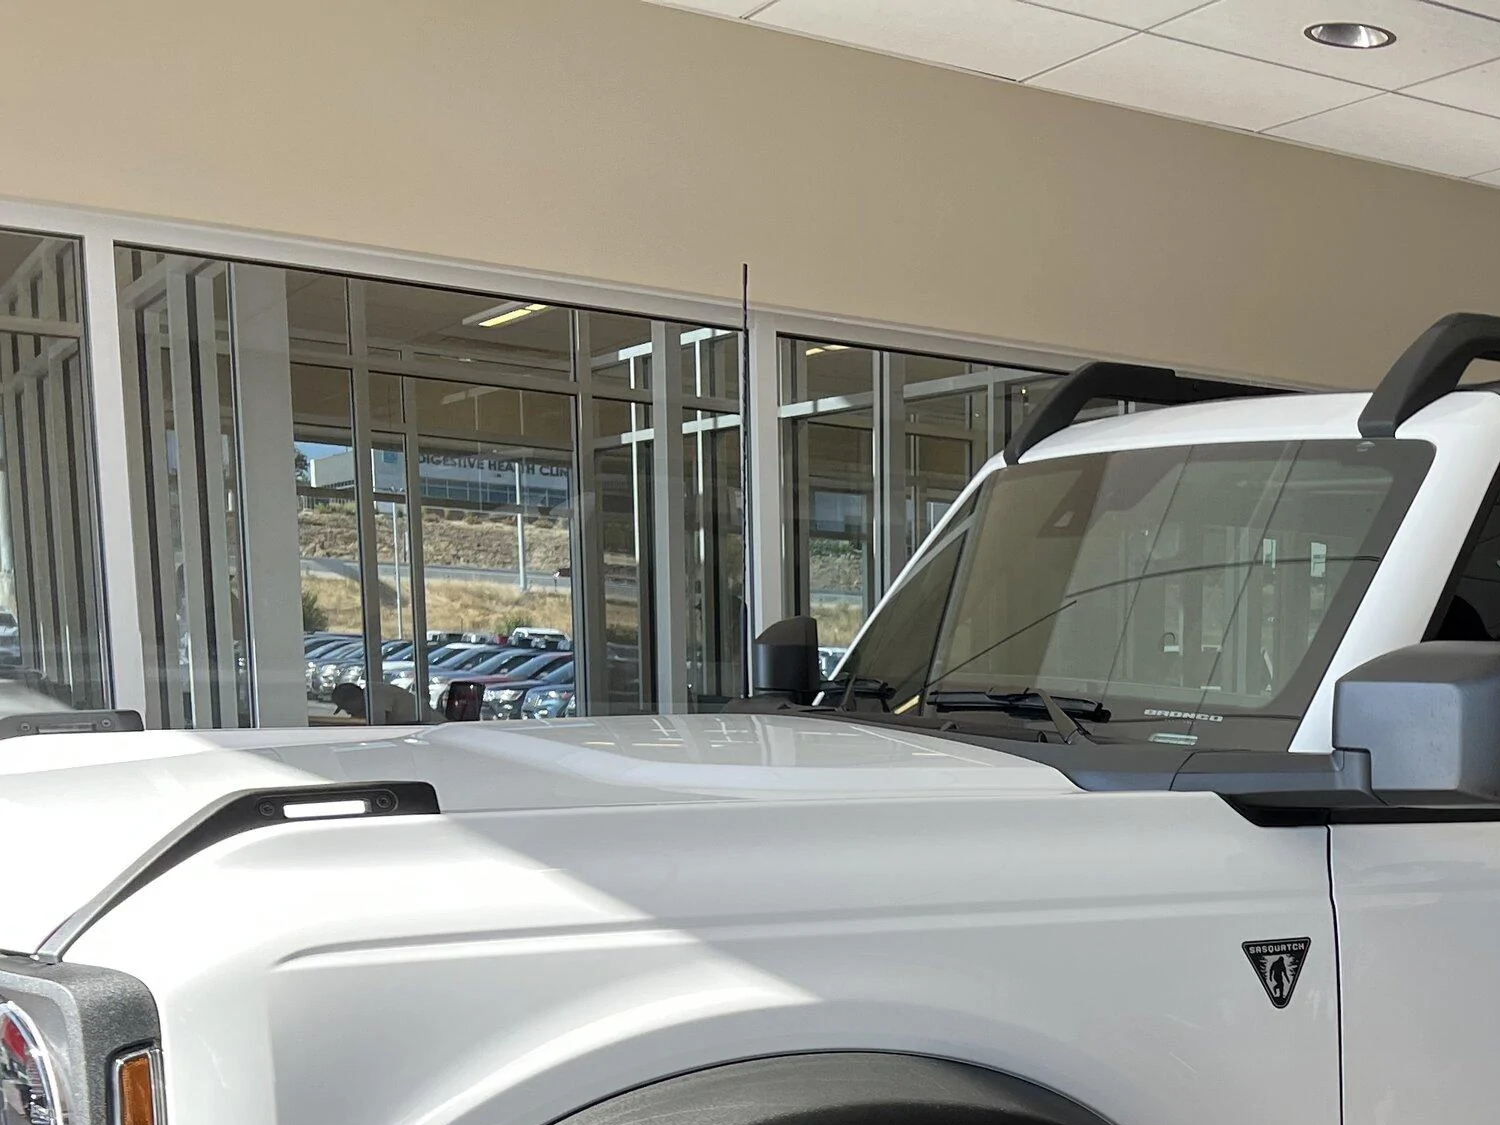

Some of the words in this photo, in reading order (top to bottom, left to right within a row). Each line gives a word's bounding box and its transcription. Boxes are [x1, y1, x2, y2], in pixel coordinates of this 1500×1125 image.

[419, 453, 485, 470] DIGESTIVE
[488, 459, 535, 476] HEATH
[1144, 708, 1223, 722] BRONCO
[1249, 943, 1305, 954] SASQUATCH
